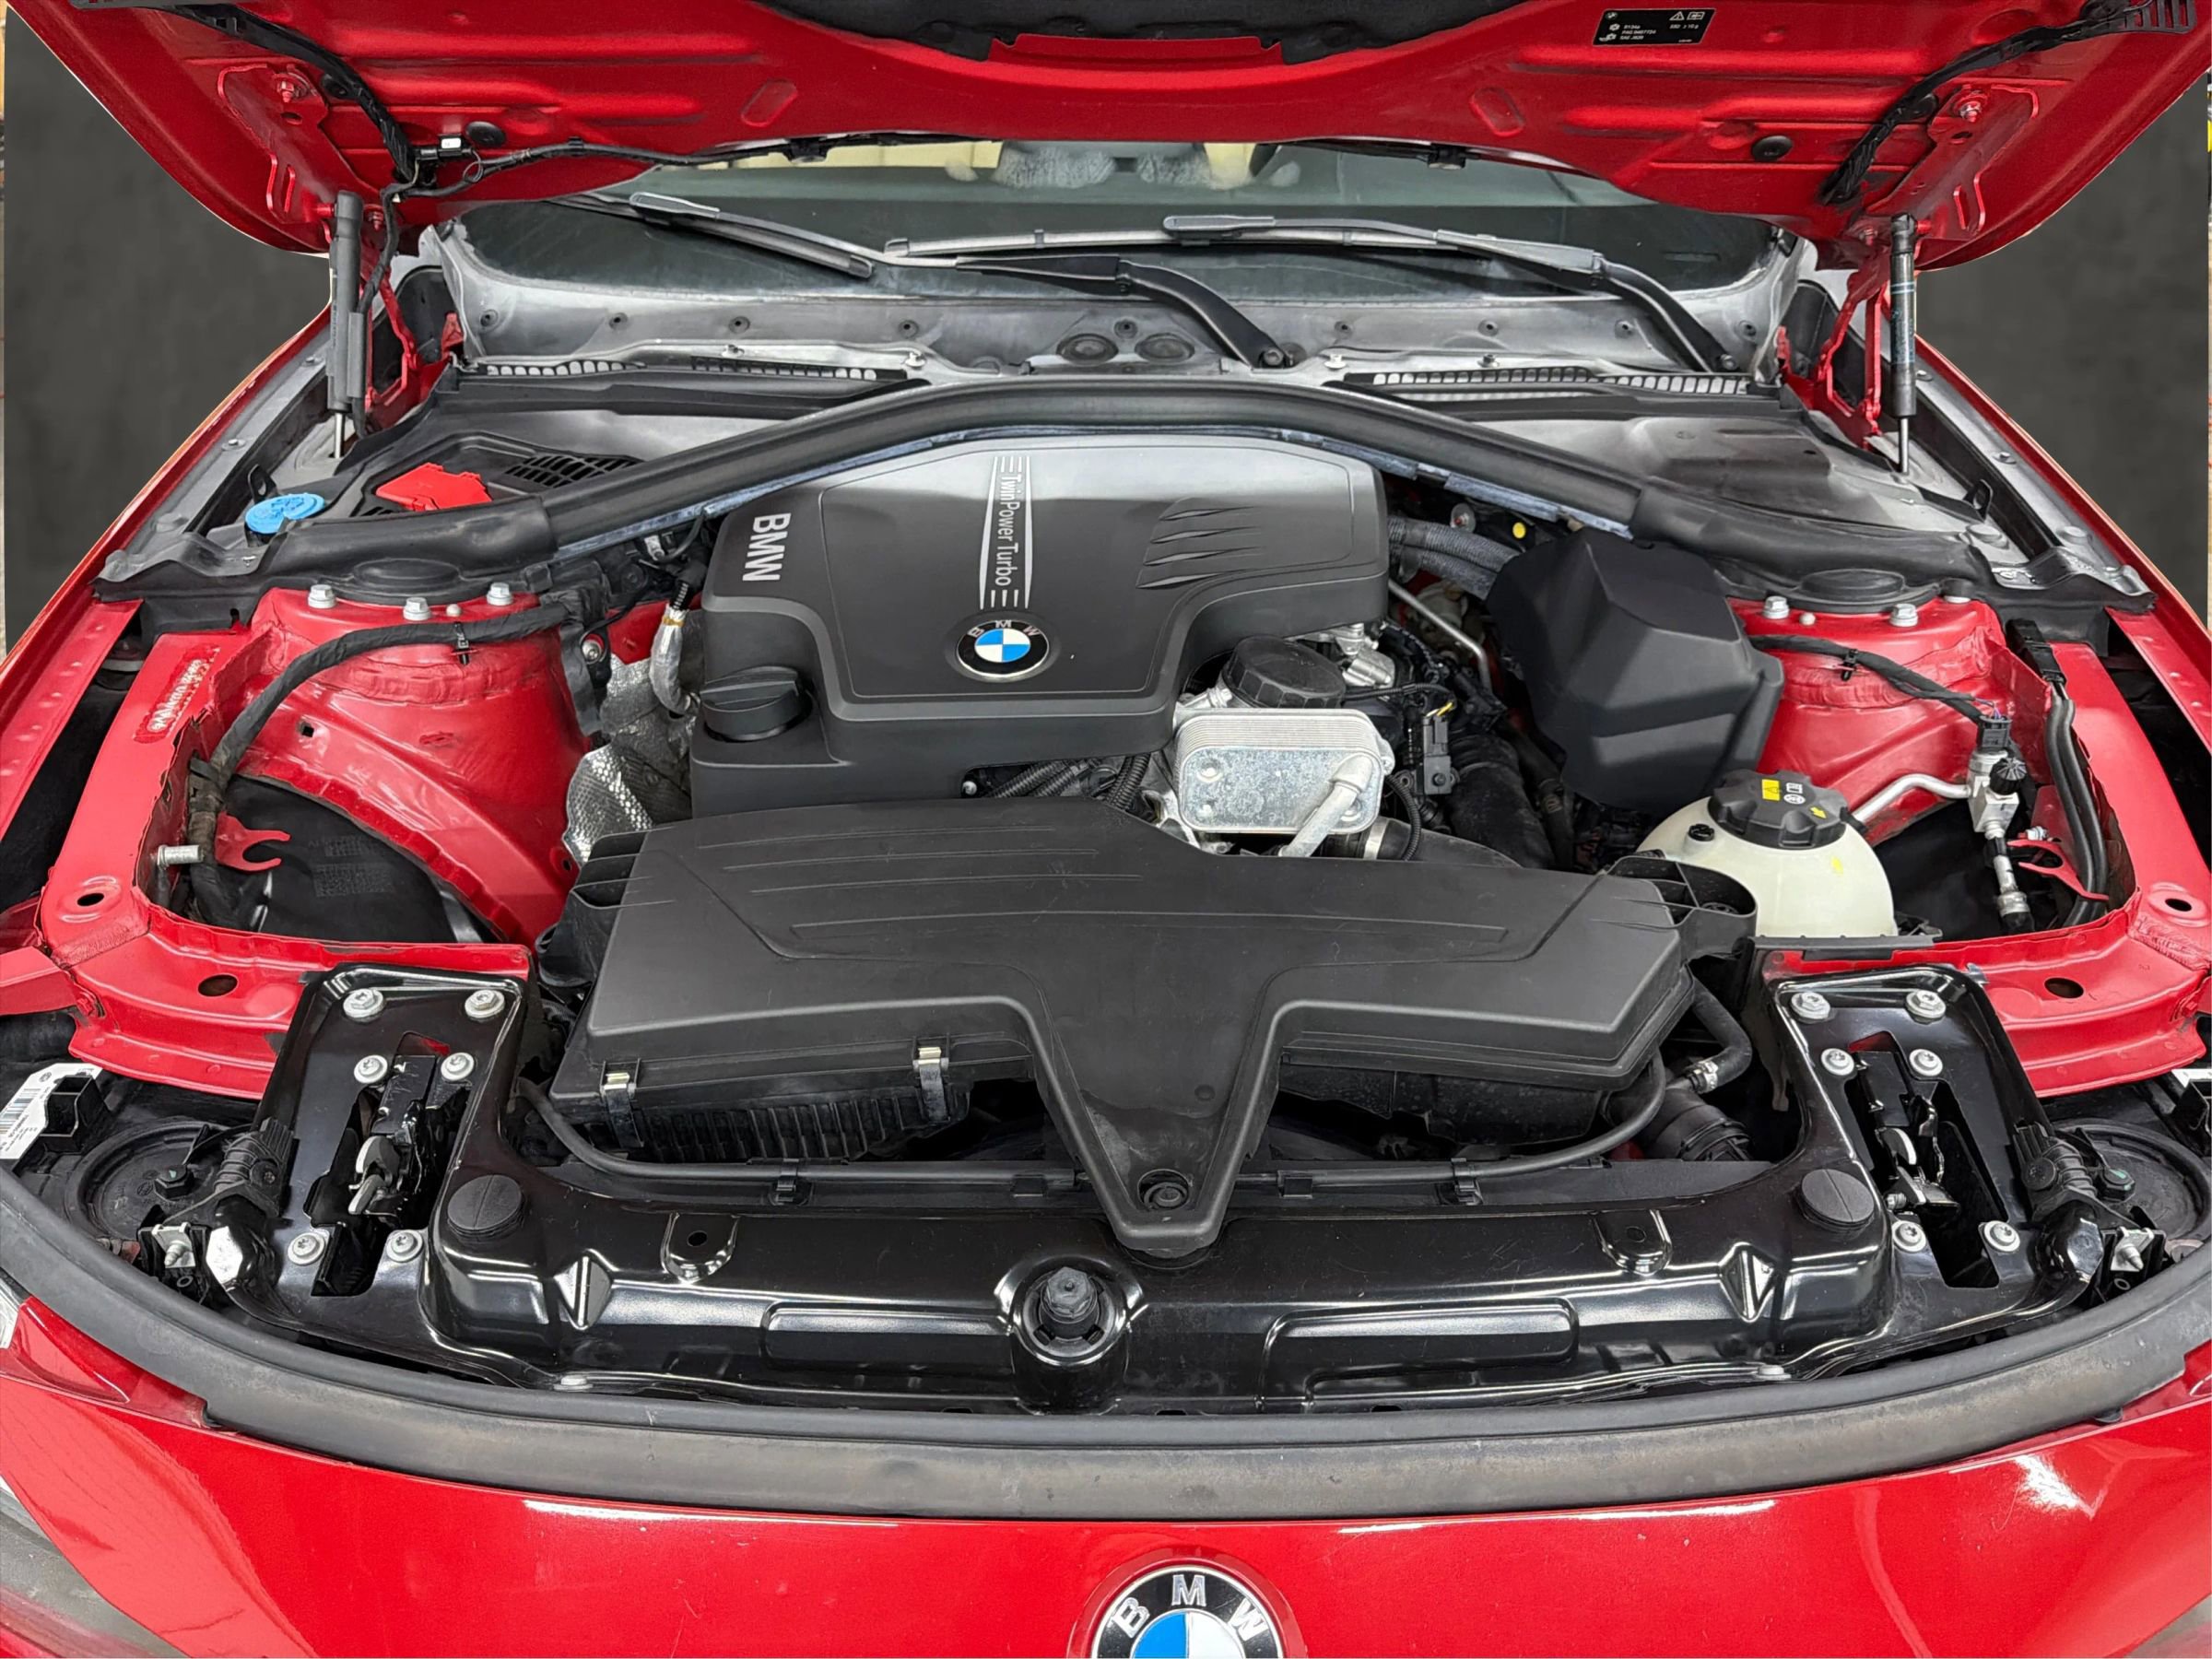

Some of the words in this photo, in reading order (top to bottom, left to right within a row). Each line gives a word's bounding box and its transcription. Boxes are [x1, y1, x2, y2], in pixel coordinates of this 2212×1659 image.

[997, 474, 1022, 541] TwinPower
[742, 512, 791, 582] BMW
[994, 542, 1019, 586] Turbo
[966, 619, 1041, 638] BMW
[1108, 1574, 1269, 1641] BMW
